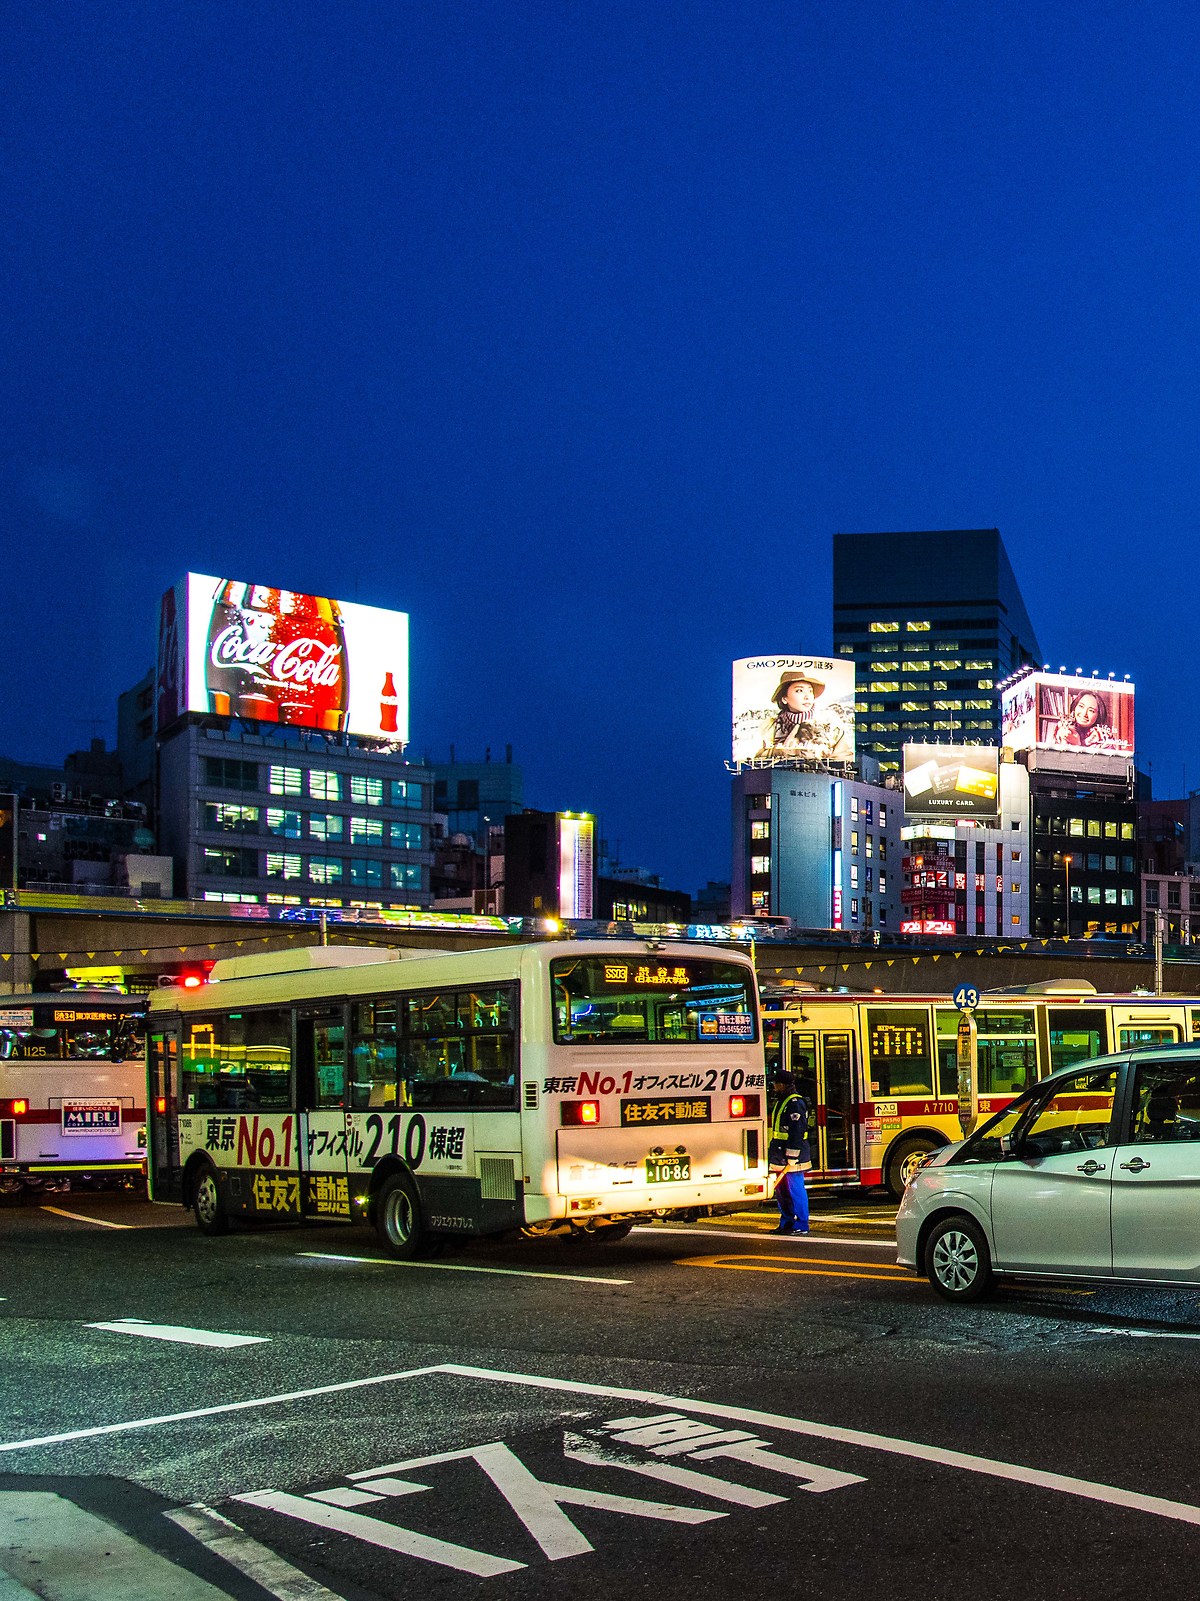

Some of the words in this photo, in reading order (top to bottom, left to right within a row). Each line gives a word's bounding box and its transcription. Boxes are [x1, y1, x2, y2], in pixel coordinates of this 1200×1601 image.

[956, 989, 978, 1007] 43
[11, 1047, 19, 1056] A
[24, 1046, 47, 1056] 1125
[624, 1101, 708, 1122] 住友不動産
[924, 1104, 930, 1113] A
[933, 1102, 954, 1113] 7710
[979, 1100, 991, 1112] 東
[67, 1112, 117, 1122] MIBU
